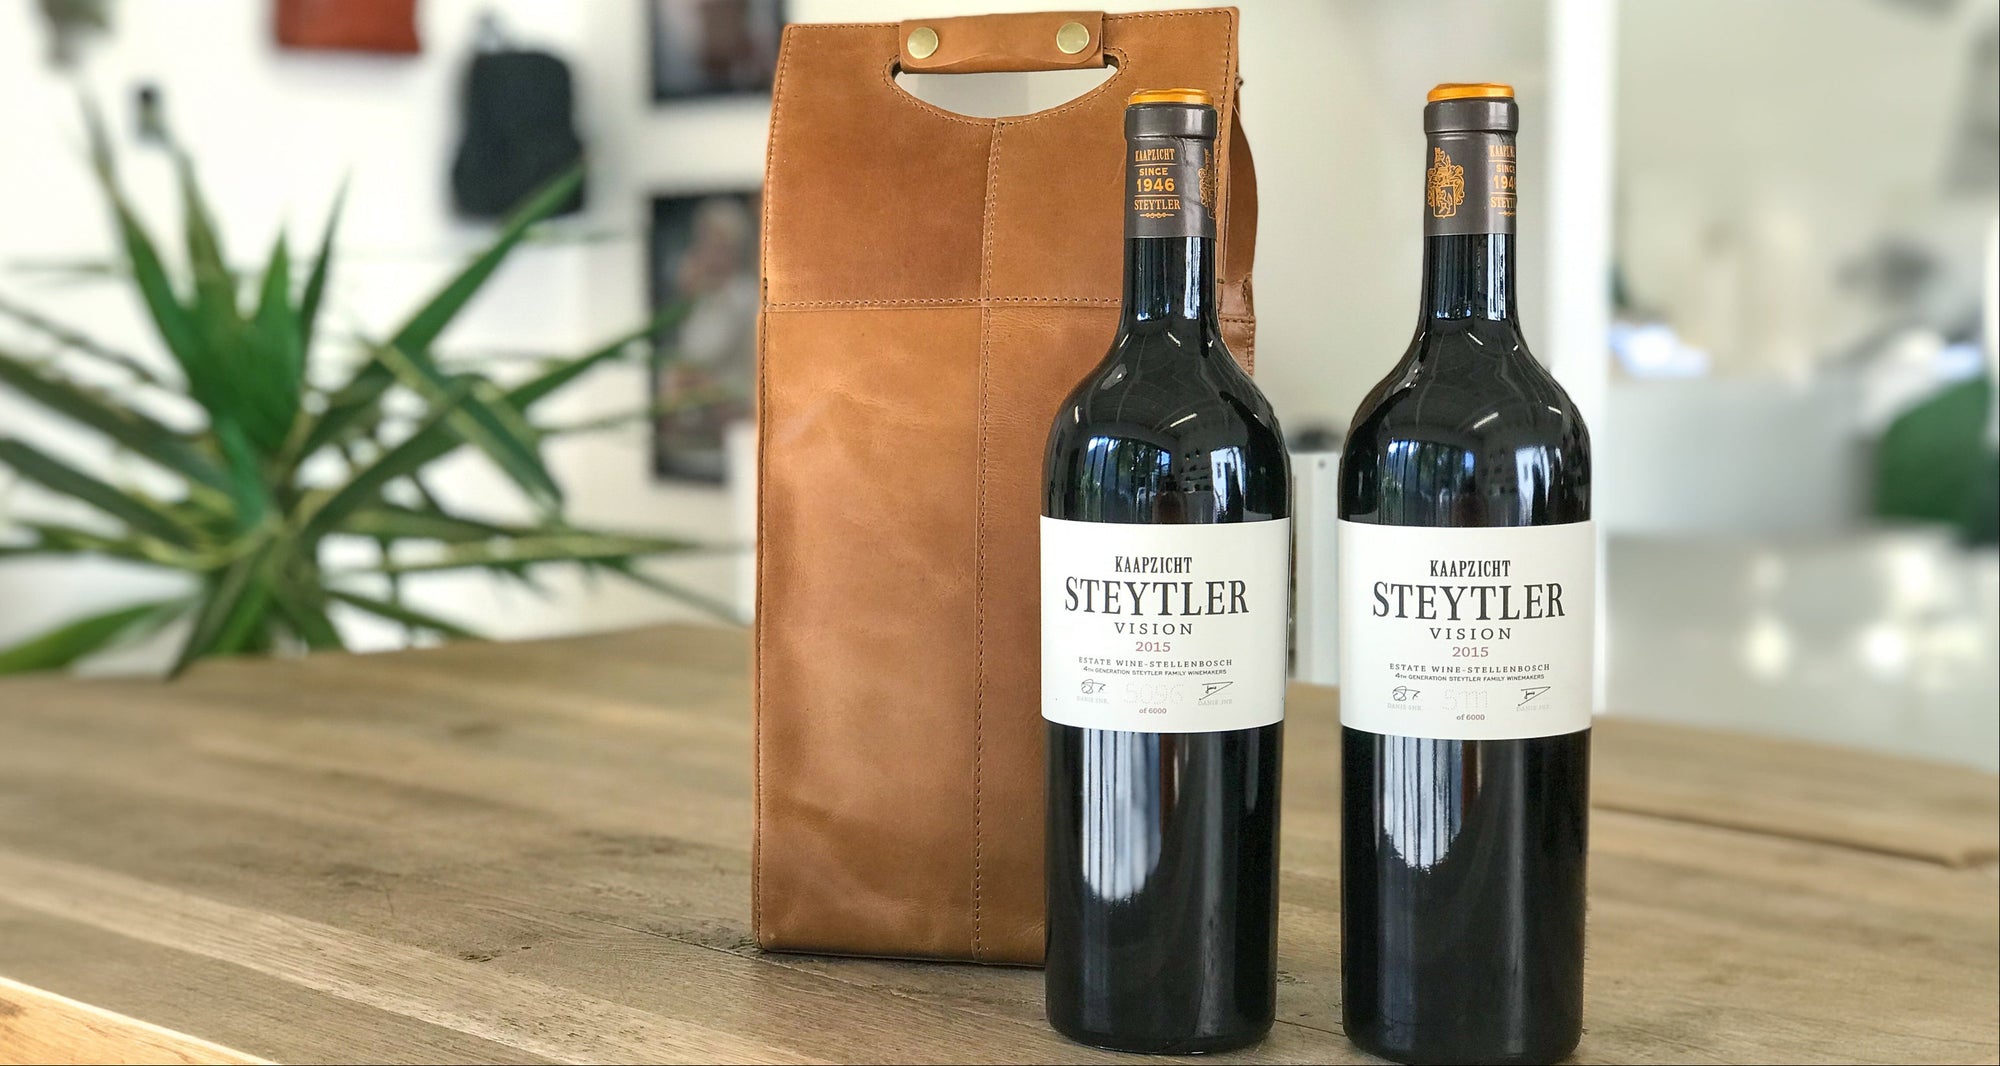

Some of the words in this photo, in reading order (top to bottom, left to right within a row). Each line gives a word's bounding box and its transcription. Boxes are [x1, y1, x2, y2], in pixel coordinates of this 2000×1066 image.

[1135, 148, 1175, 161] KAAPZICHT
[1139, 167, 1168, 176] SINCE
[1136, 178, 1175, 192] 1946
[1493, 175, 1516, 189] 194
[1134, 199, 1181, 210] STEYTLER
[1115, 556, 1192, 574] KAAPZICHT
[1430, 560, 1511, 577] KAAPZICHT
[1065, 576, 1249, 616] STEYTLER
[1373, 581, 1565, 621] STEYTLER
[1114, 622, 1193, 635] VISION
[1429, 627, 1511, 640] VISION
[1135, 641, 1171, 652] 2015
[1452, 646, 1489, 657] 2015
[1078, 656, 1111, 666] ESTATE
[1389, 663, 1426, 672] ESTATE
